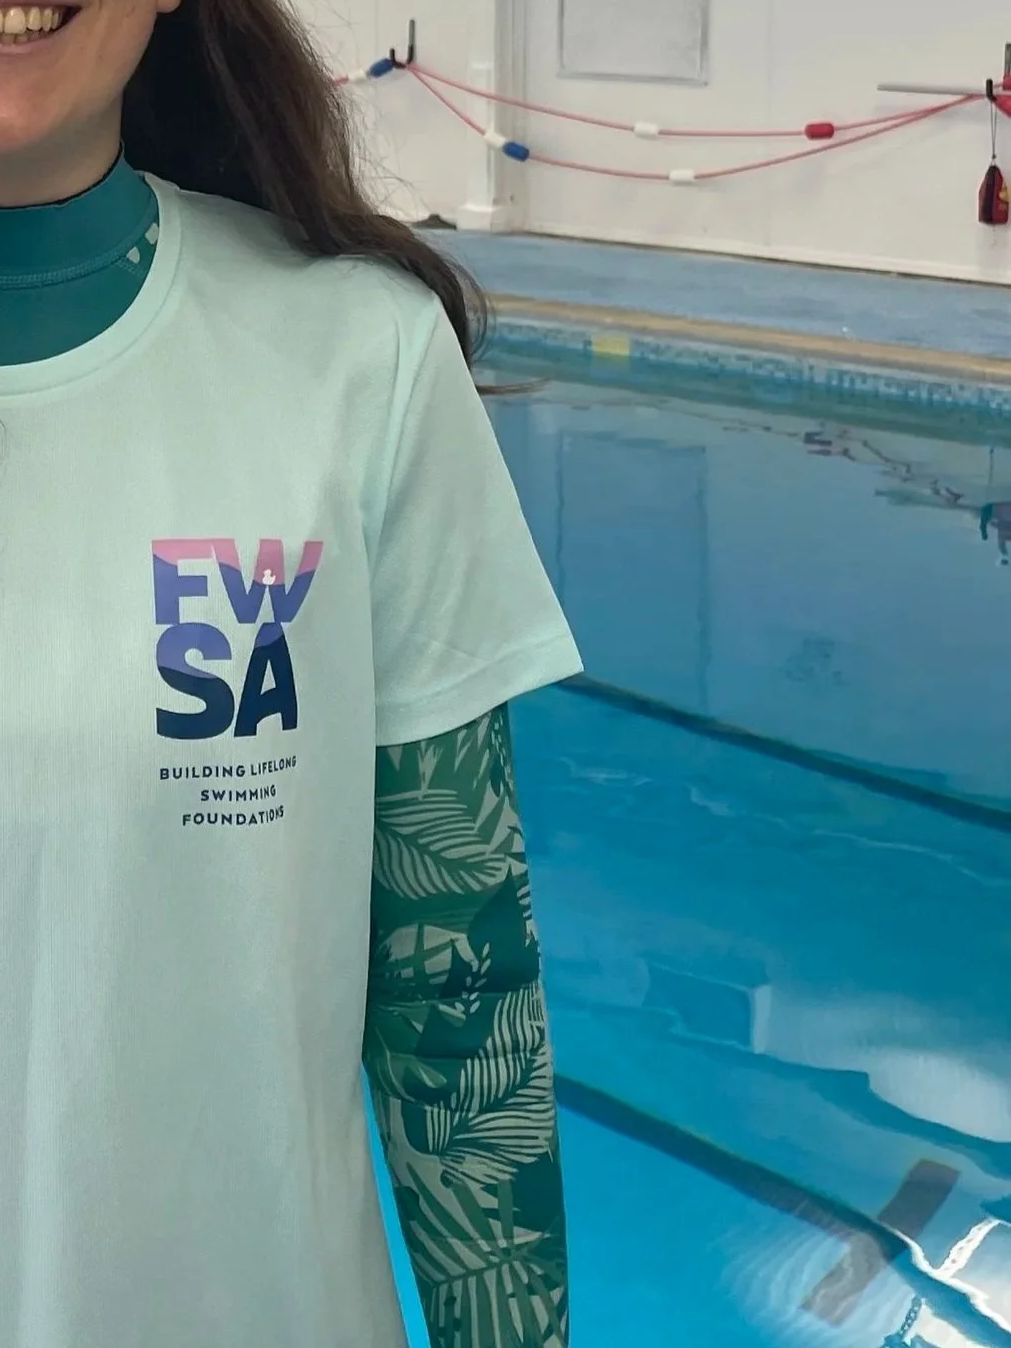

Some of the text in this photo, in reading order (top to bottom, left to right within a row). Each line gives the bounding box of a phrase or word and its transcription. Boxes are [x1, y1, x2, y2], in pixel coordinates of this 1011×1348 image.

[152, 538, 324, 625] FW
[155, 622, 298, 740] SA
[159, 755, 297, 780] BUILDING LIFELONG
[200, 784, 277, 802] SWIMMING
[182, 805, 285, 827] FOUNDATIONS
